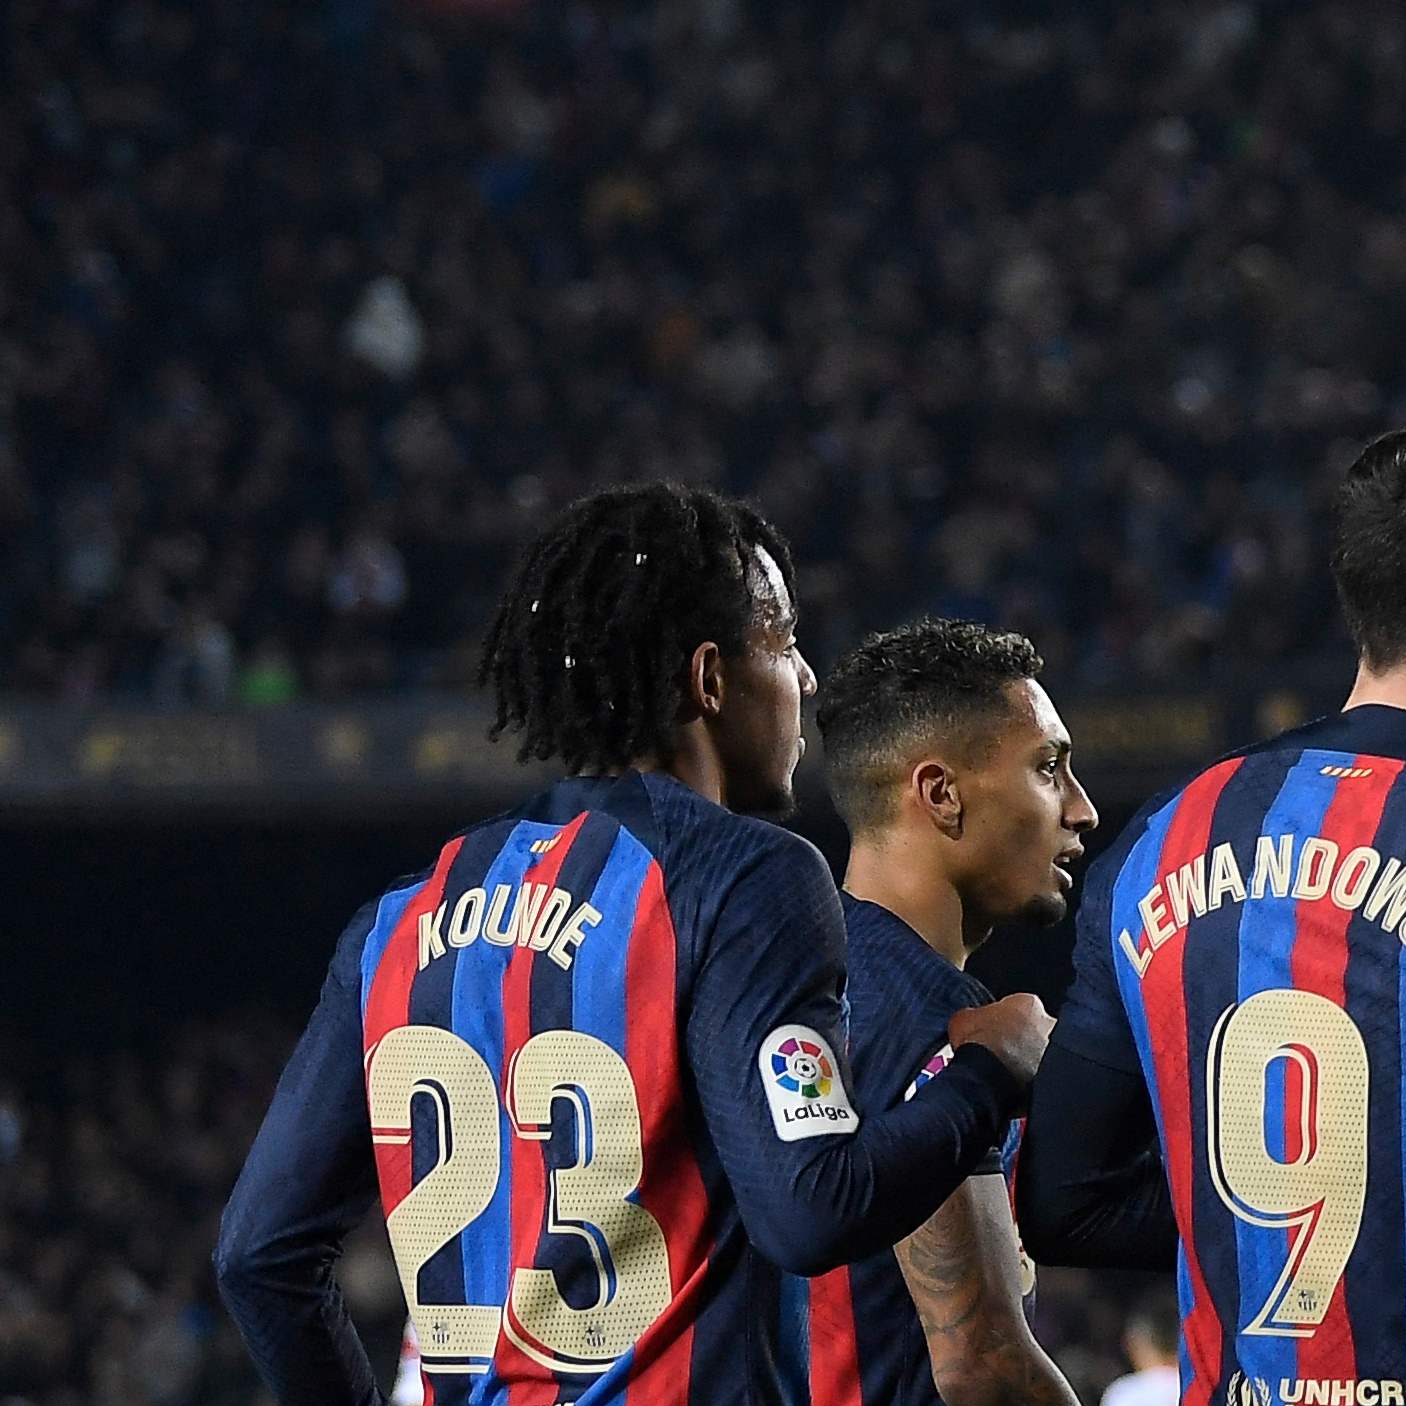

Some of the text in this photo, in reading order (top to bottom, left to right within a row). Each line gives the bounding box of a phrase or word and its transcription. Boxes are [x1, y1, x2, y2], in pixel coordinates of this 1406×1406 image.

[417, 881, 603, 972] KOUNDE
[363, 1025, 674, 1374] 23
[783, 1103, 850, 1123] LaLiga
[1207, 988, 1369, 1338] 9
